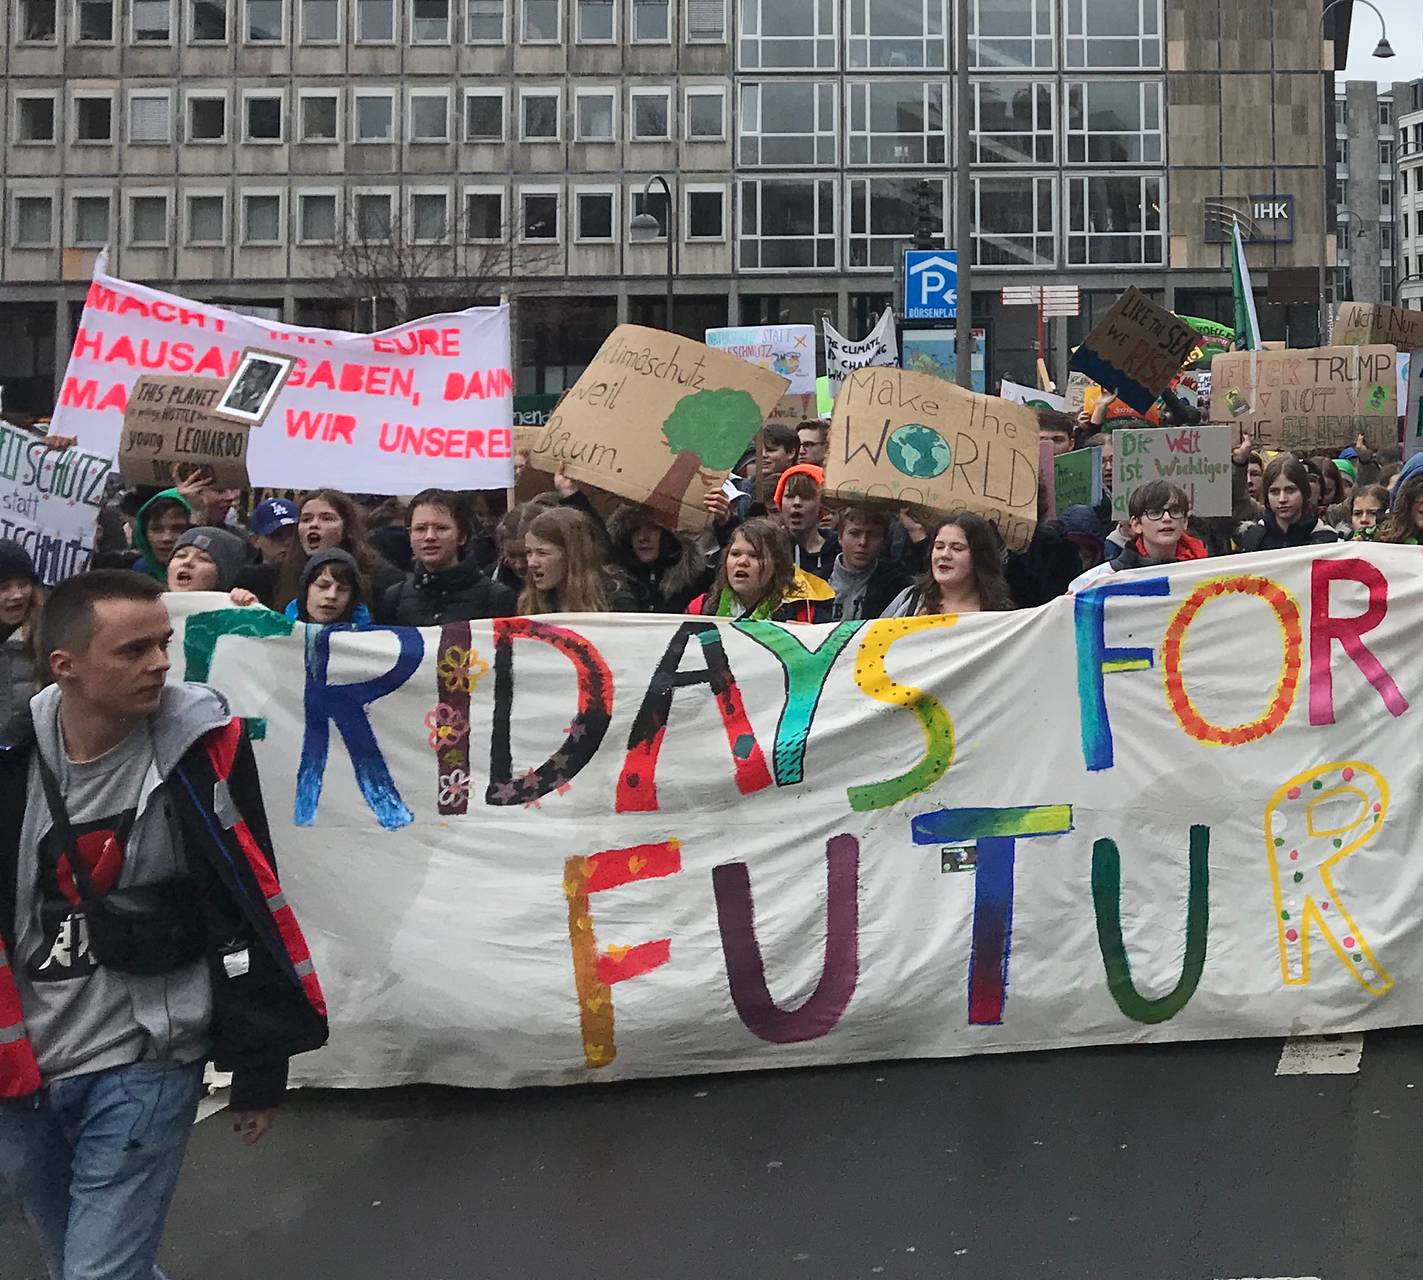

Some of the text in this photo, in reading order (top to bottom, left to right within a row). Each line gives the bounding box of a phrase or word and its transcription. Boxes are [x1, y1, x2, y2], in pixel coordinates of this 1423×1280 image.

[1254, 203, 1288, 219] IHK
[921, 271, 946, 304] P
[909, 307, 957, 319] BÖRSENPLAT
[1348, 306, 1383, 330] Nicht
[1389, 309, 1418, 334] Nur
[762, 328, 792, 344] STATT
[1107, 323, 1129, 347] WE
[1121, 294, 1150, 327] LIKE
[1158, 323, 1193, 365] SEA
[841, 336, 880, 354] CLIMATE
[1220, 359, 1301, 389] FUCK
[1306, 355, 1391, 382] TRUMP
[137, 382, 166, 403] THIS
[168, 386, 219, 406] PLANET
[847, 372, 1017, 438] Make the
[1280, 387, 1337, 413] NOT
[126, 427, 243, 457] young LEONARDO
[285, 408, 512, 459] WIR UNSERE!
[533, 415, 623, 474] Baum.
[1121, 430, 1201, 456] Die Welt
[1209, 415, 1397, 448] THE CLIMATE
[1120, 456, 1144, 482] ist
[2, 490, 39, 521] statt
[184, 558, 1409, 832] FRIDAYS FOR
